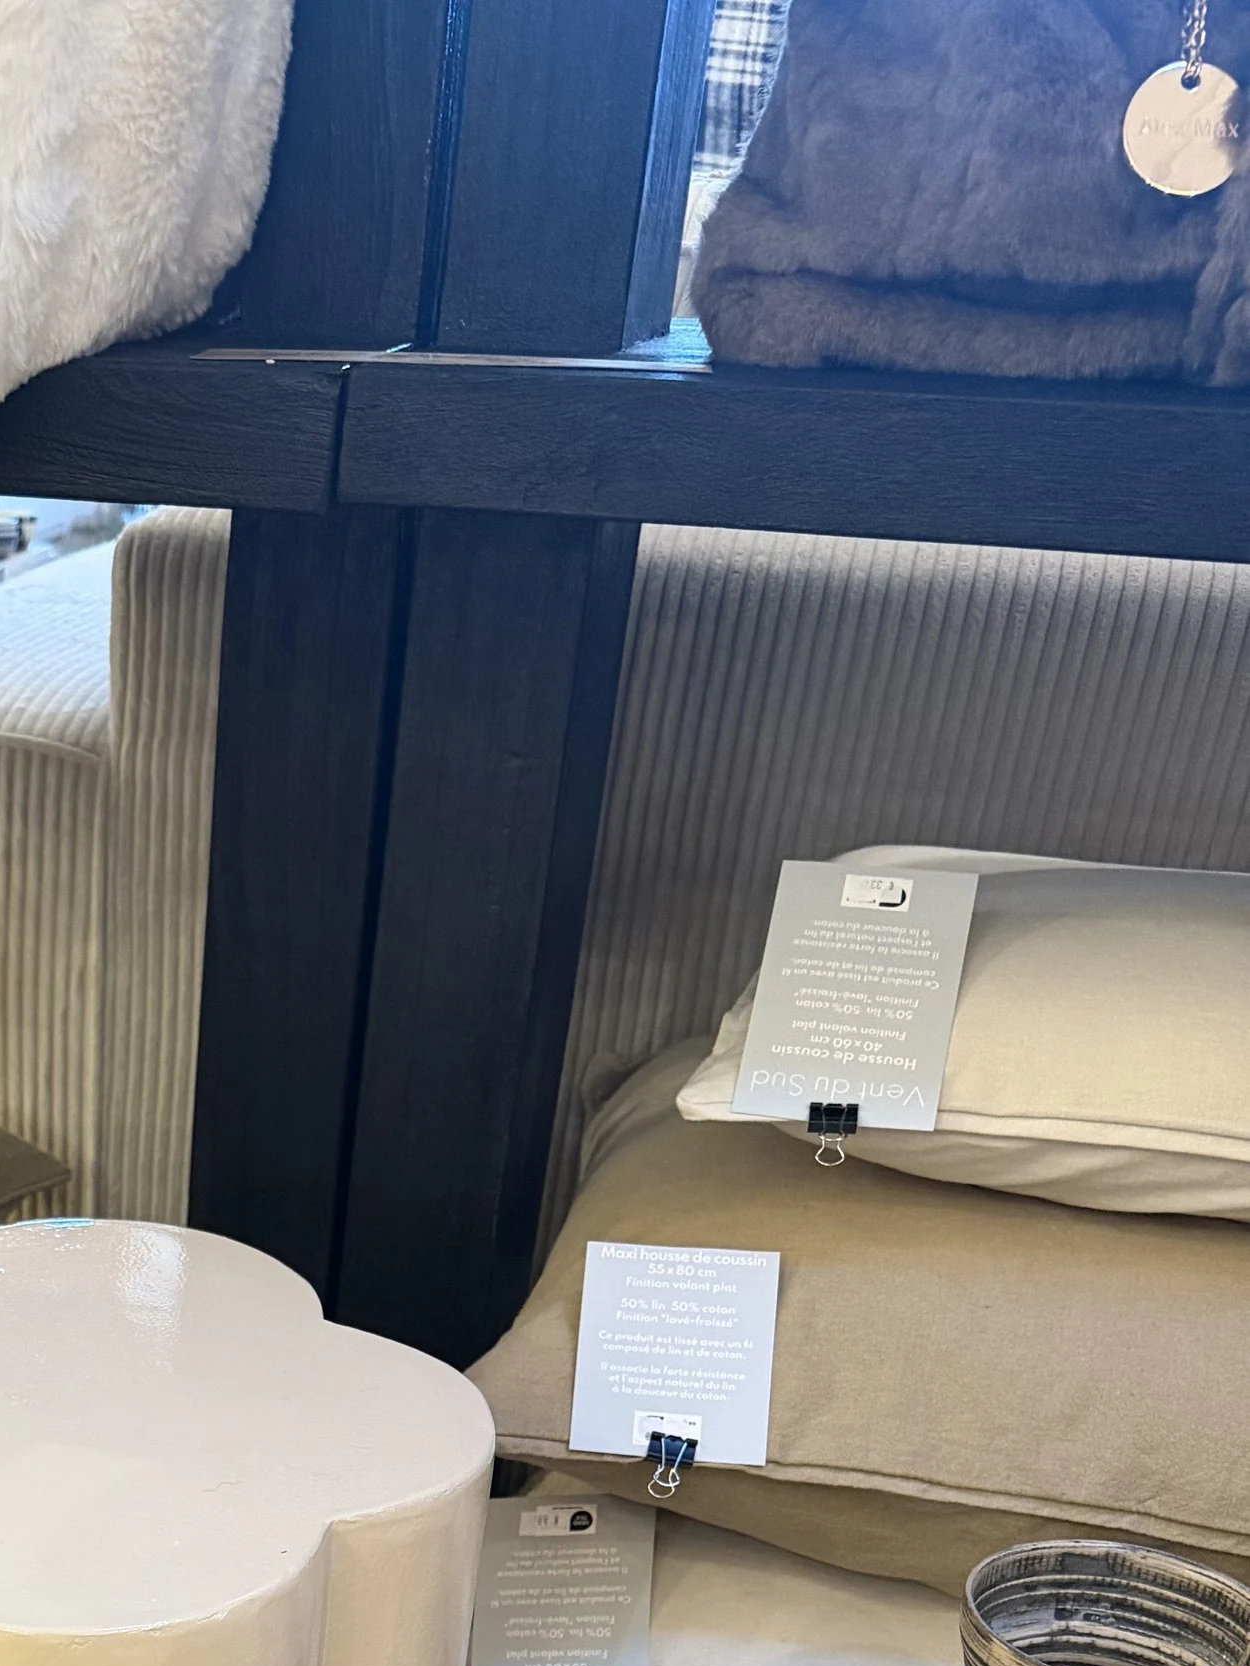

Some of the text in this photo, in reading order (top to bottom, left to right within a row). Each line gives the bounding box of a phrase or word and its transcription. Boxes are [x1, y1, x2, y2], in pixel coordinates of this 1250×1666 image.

[1193, 116, 1238, 139] Max
[909, 928, 920, 937] la
[920, 939, 931, 947] et
[877, 947, 888, 956] la
[826, 961, 840, 969] de
[841, 961, 852, 970] et
[854, 964, 868, 973] lin
[870, 965, 884, 974] de
[887, 965, 936, 978] composé
[864, 975, 880, 983] est
[882, 975, 922, 987] produit
[924, 980, 940, 990] Ce
[875, 995, 919, 1007] Finition
[795, 999, 913, 1020] 50% lin 50% coton
[819, 1022, 857, 1034] volant
[810, 1034, 830, 1044] cm
[860, 1027, 906, 1041] Finition
[833, 1038, 851, 1049] 60
[863, 1041, 882, 1051] 40
[771, 1044, 917, 1070] Housse de coussin
[750, 1070, 925, 1108] Vent du Sud
[600, 1246, 767, 1267] Maxi housse de coussin
[648, 1264, 665, 1274] 55
[677, 1266, 695, 1276] 80
[697, 1268, 717, 1277] cm
[626, 1276, 738, 1294] Finition volant plat
[620, 1298, 736, 1314] 50% lin 50% coton
[616, 1311, 658, 1322] Finition
[598, 1330, 613, 1340] Ce
[614, 1332, 654, 1344] produit
[656, 1336, 672, 1344] est
[674, 1336, 698, 1346] tissé
[700, 1339, 725, 1348] avec
[727, 1341, 742, 1349] un
[603, 1343, 650, 1356] composé
[652, 1346, 666, 1355] de
[668, 1346, 682, 1355] lin
[684, 1348, 695, 1356] et
[696, 1348, 710, 1357] de
[609, 1363, 649, 1373] associe
[651, 1365, 662, 1374] la
[663, 1365, 689, 1376] forte
[691, 1368, 747, 1380] résistance
[608, 1374, 735, 1391] et l'aspect naturel du lin
[612, 1384, 619, 1393] à
[621, 1384, 633, 1393] la
[634, 1386, 678, 1397] douceur
[680, 1390, 694, 1399] du
[576, 1615, 615, 1624] Finition
[539, 1628, 564, 1638] 50%
[569, 1628, 583, 1638] lin
[586, 1627, 611, 1637] 50%
[567, 1649, 608, 1658] Finition
